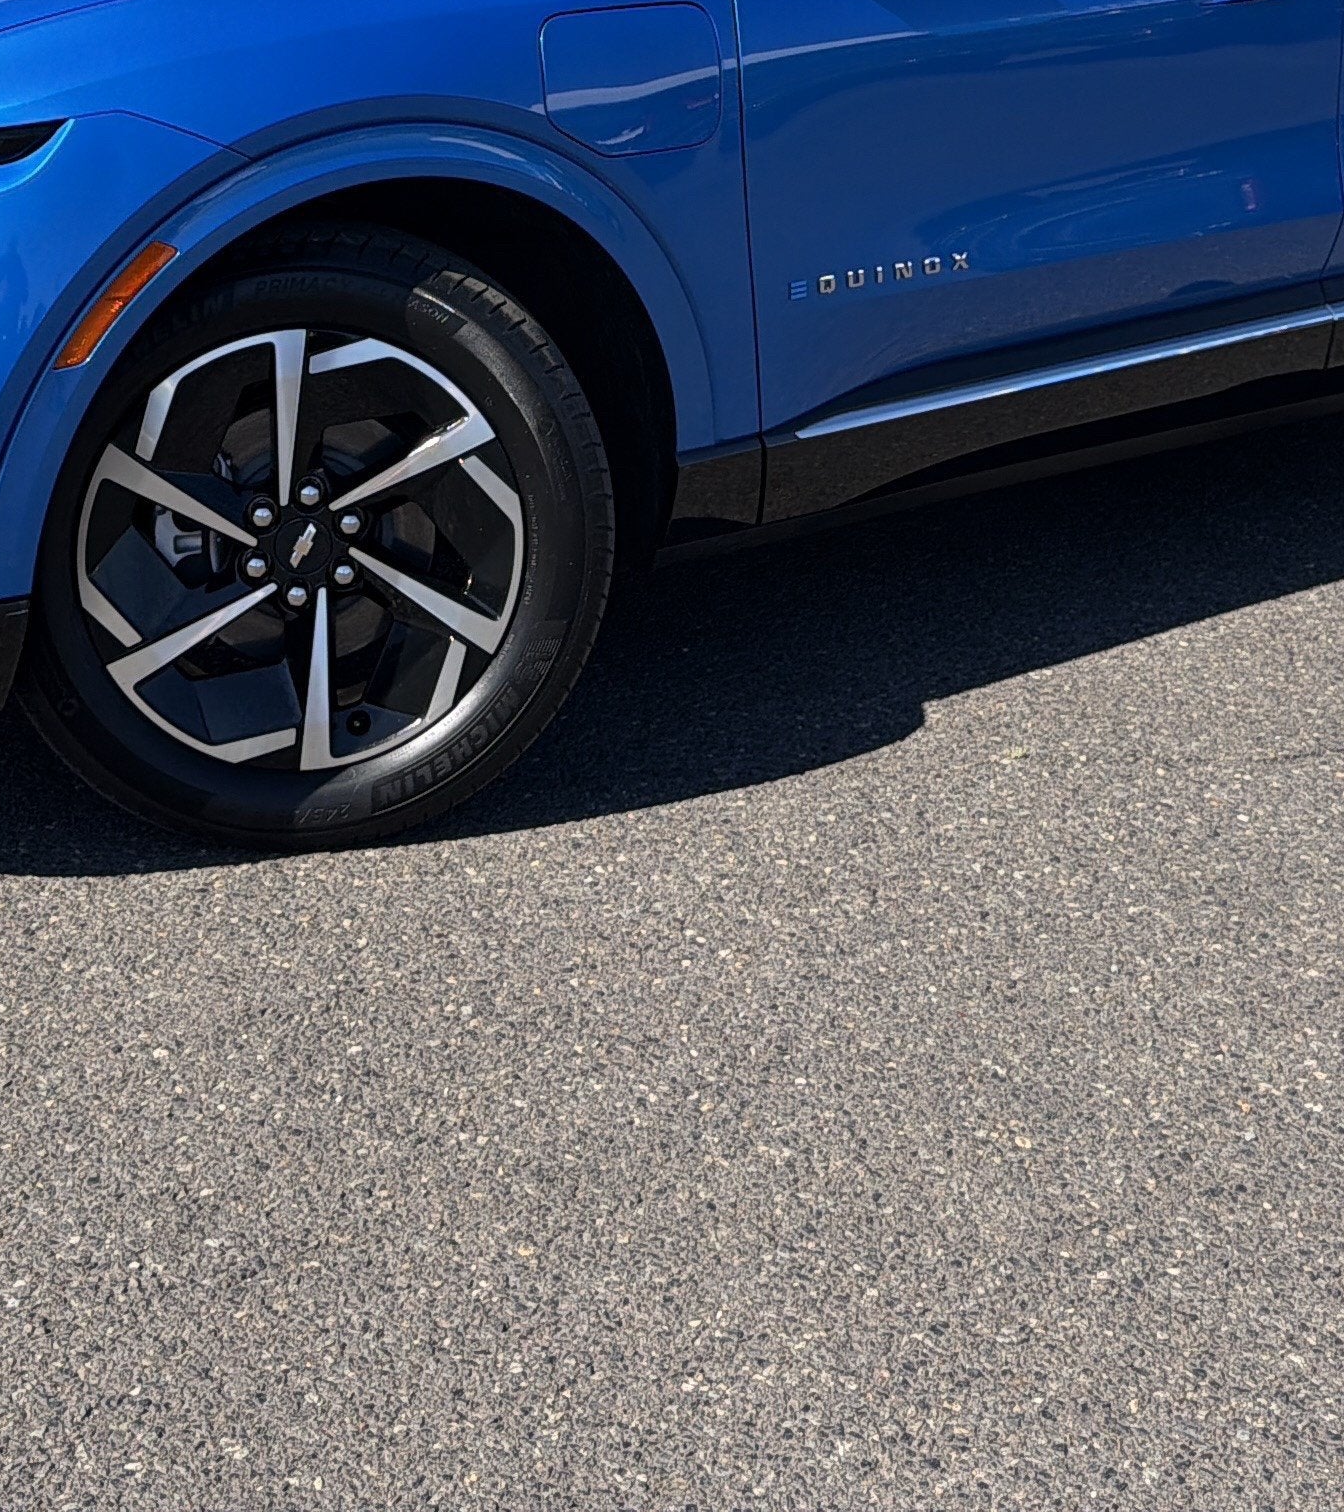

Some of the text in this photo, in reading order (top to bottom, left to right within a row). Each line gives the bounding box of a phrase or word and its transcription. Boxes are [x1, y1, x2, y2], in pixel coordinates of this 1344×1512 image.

[255, 276, 352, 296] PRIMACY
[790, 251, 969, 301] EQUINOX
[374, 688, 525, 805] MICHELIN
